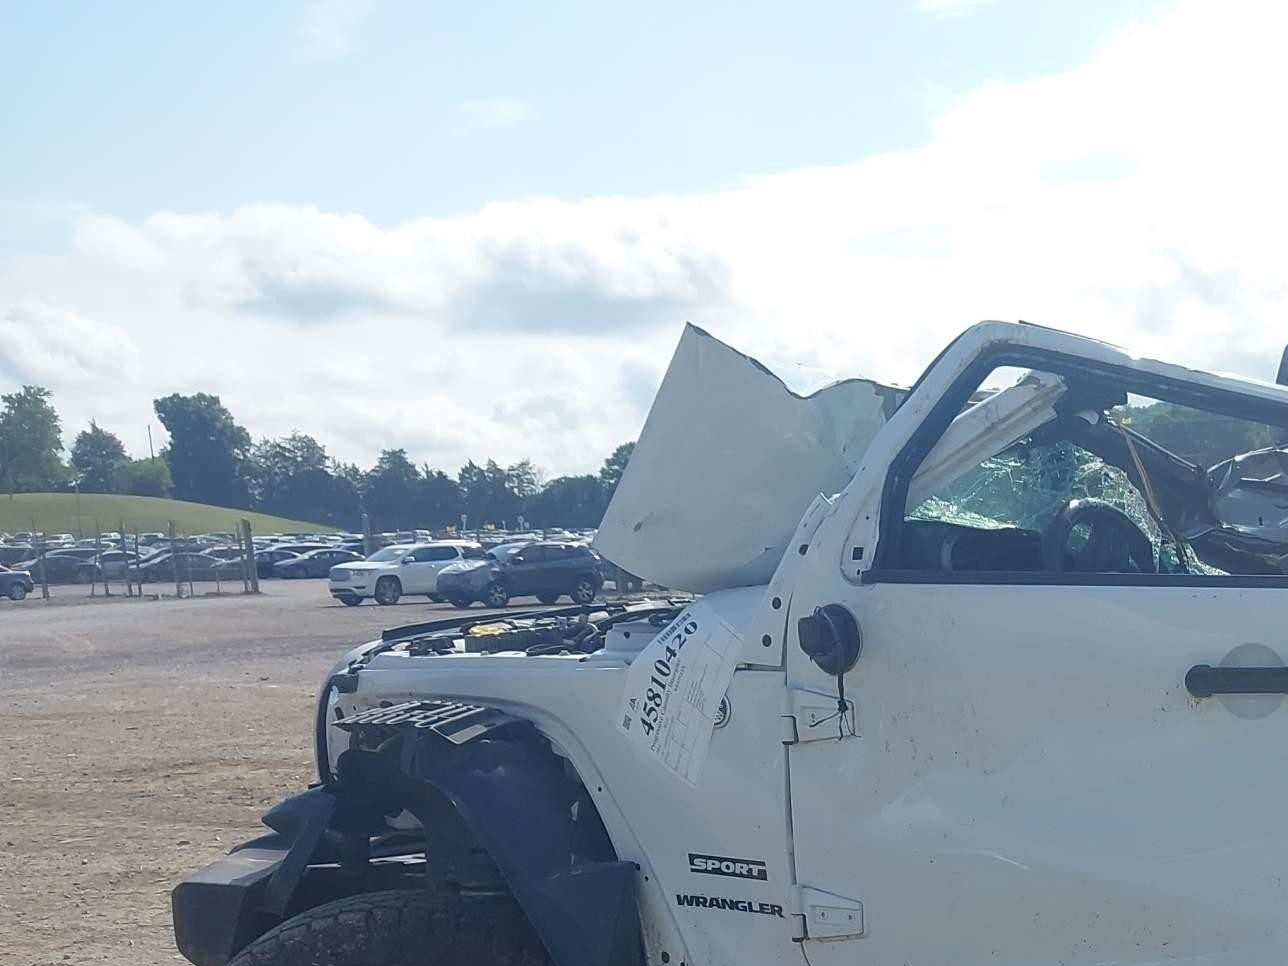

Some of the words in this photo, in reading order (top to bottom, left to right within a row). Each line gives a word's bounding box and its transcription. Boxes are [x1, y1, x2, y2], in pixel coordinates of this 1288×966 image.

[640, 621, 698, 737] 45810420
[693, 857, 767, 877] SPORT
[676, 893, 786, 919] WRANGLER
